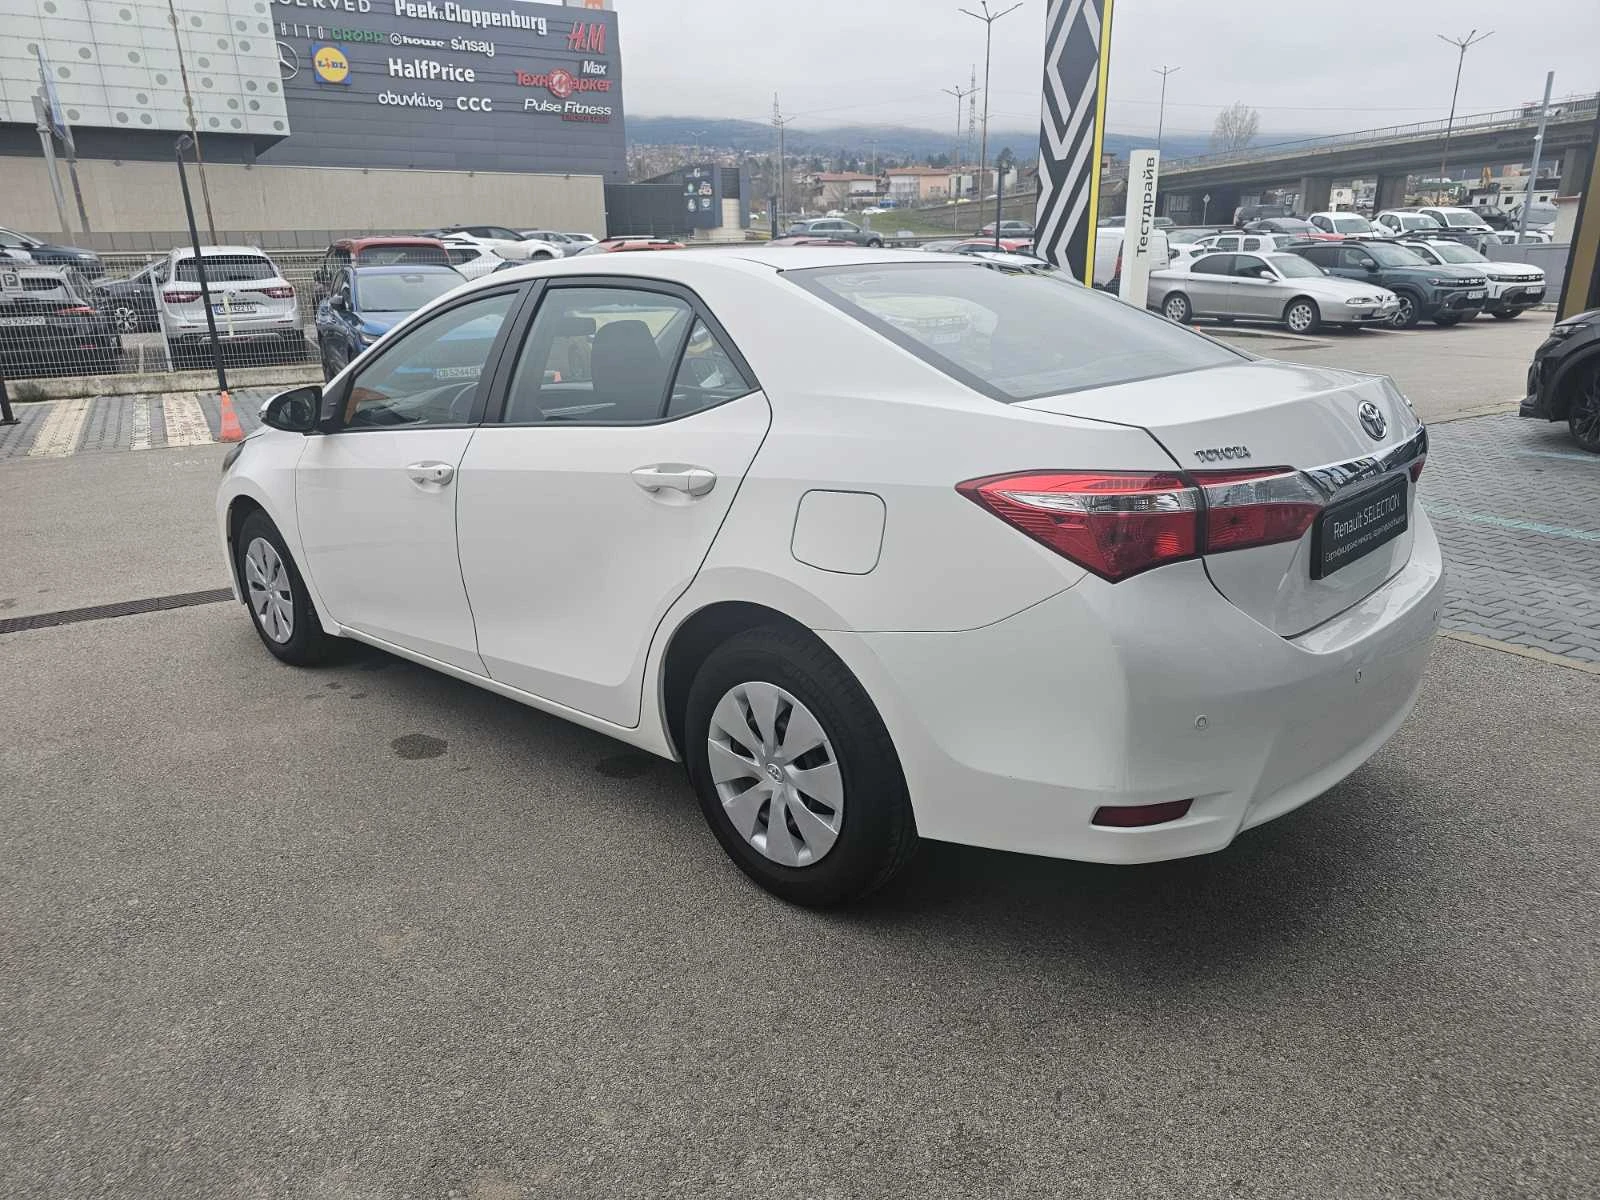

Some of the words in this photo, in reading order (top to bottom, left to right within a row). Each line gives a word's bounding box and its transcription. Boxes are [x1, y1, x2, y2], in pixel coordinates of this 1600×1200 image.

[388, 57, 475, 82] HalfPrice
[582, 60, 606, 75] Max
[378, 90, 443, 110] obuvki.bg
[456, 96, 493, 112] CCC
[524, 98, 562, 113] Pulse
[564, 101, 612, 115] Fitness
[1136, 157, 1155, 257] Тестдрайв
[1194, 445, 1252, 464] TOYOTA
[1333, 511, 1363, 541] Renault
[1363, 493, 1400, 526] SELECTION
